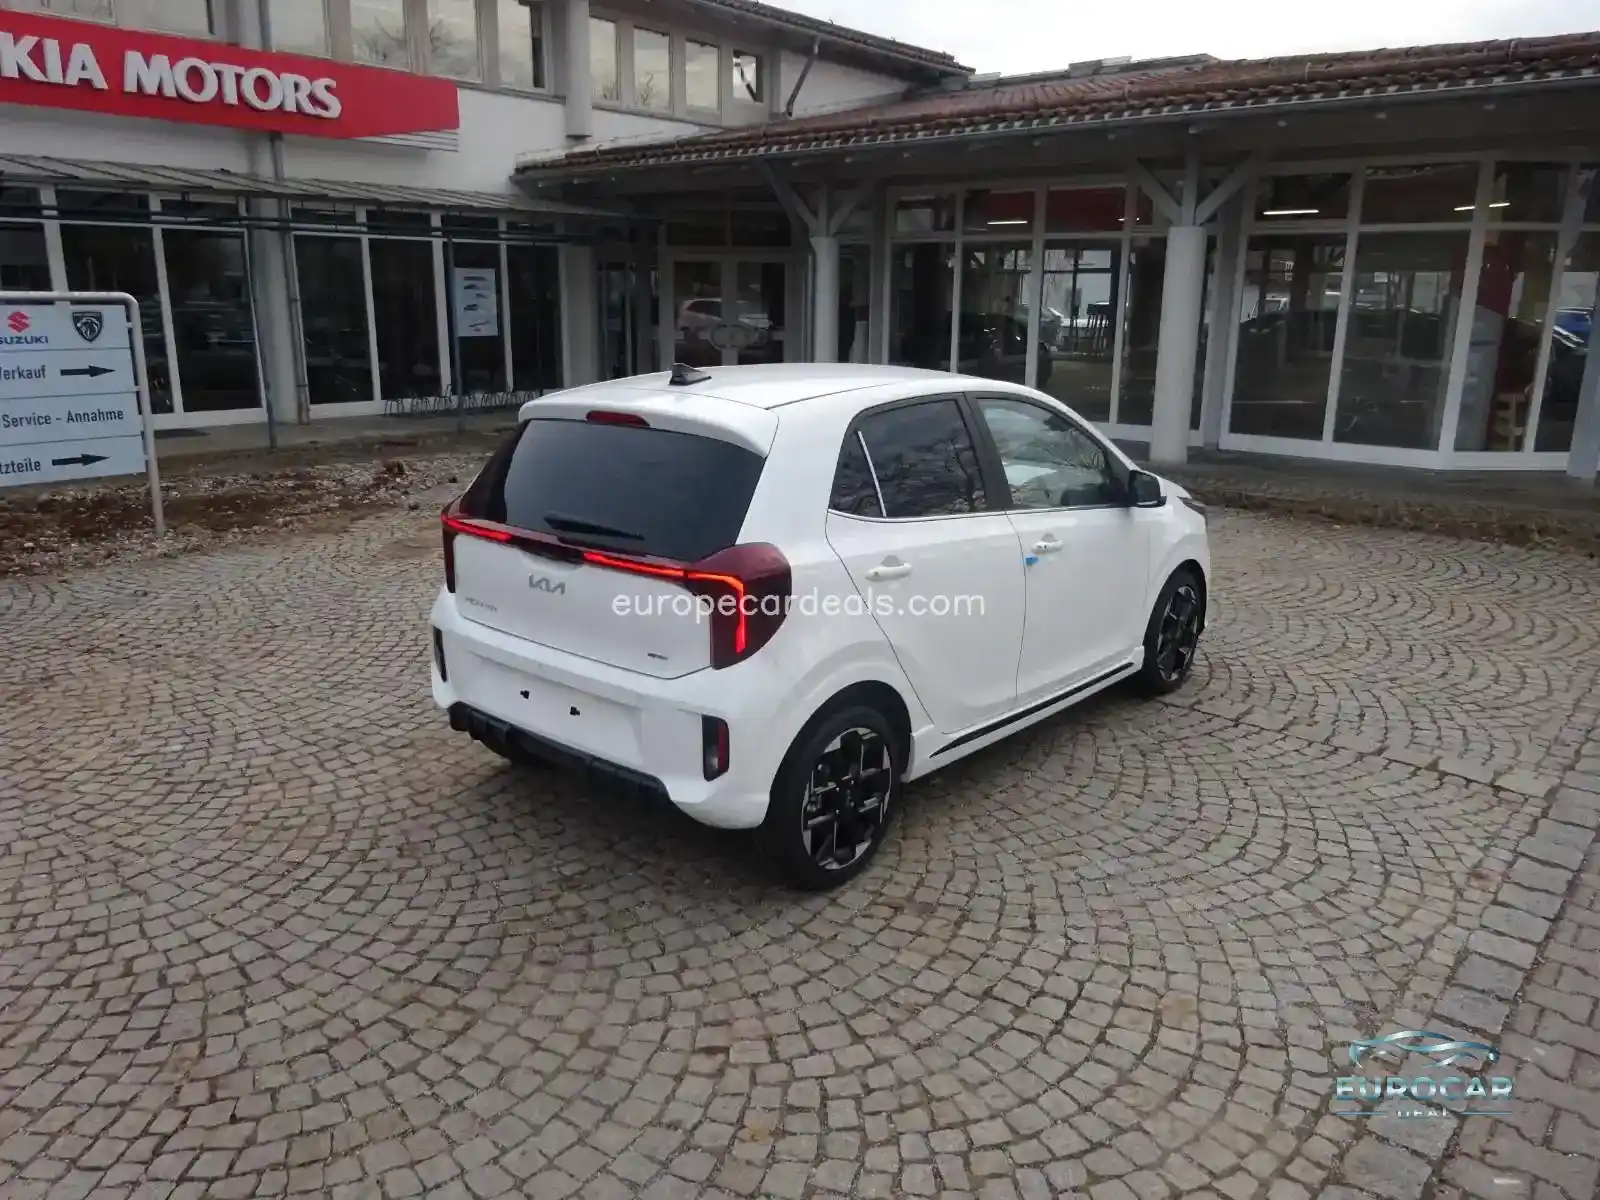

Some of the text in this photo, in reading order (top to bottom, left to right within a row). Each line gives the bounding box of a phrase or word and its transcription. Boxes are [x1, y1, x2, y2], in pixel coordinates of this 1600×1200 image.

[0, 31, 342, 119] KIA MOTORS
[0, 364, 46, 381] erkauf
[3, 411, 52, 428] Service
[66, 408, 124, 424] Annahme
